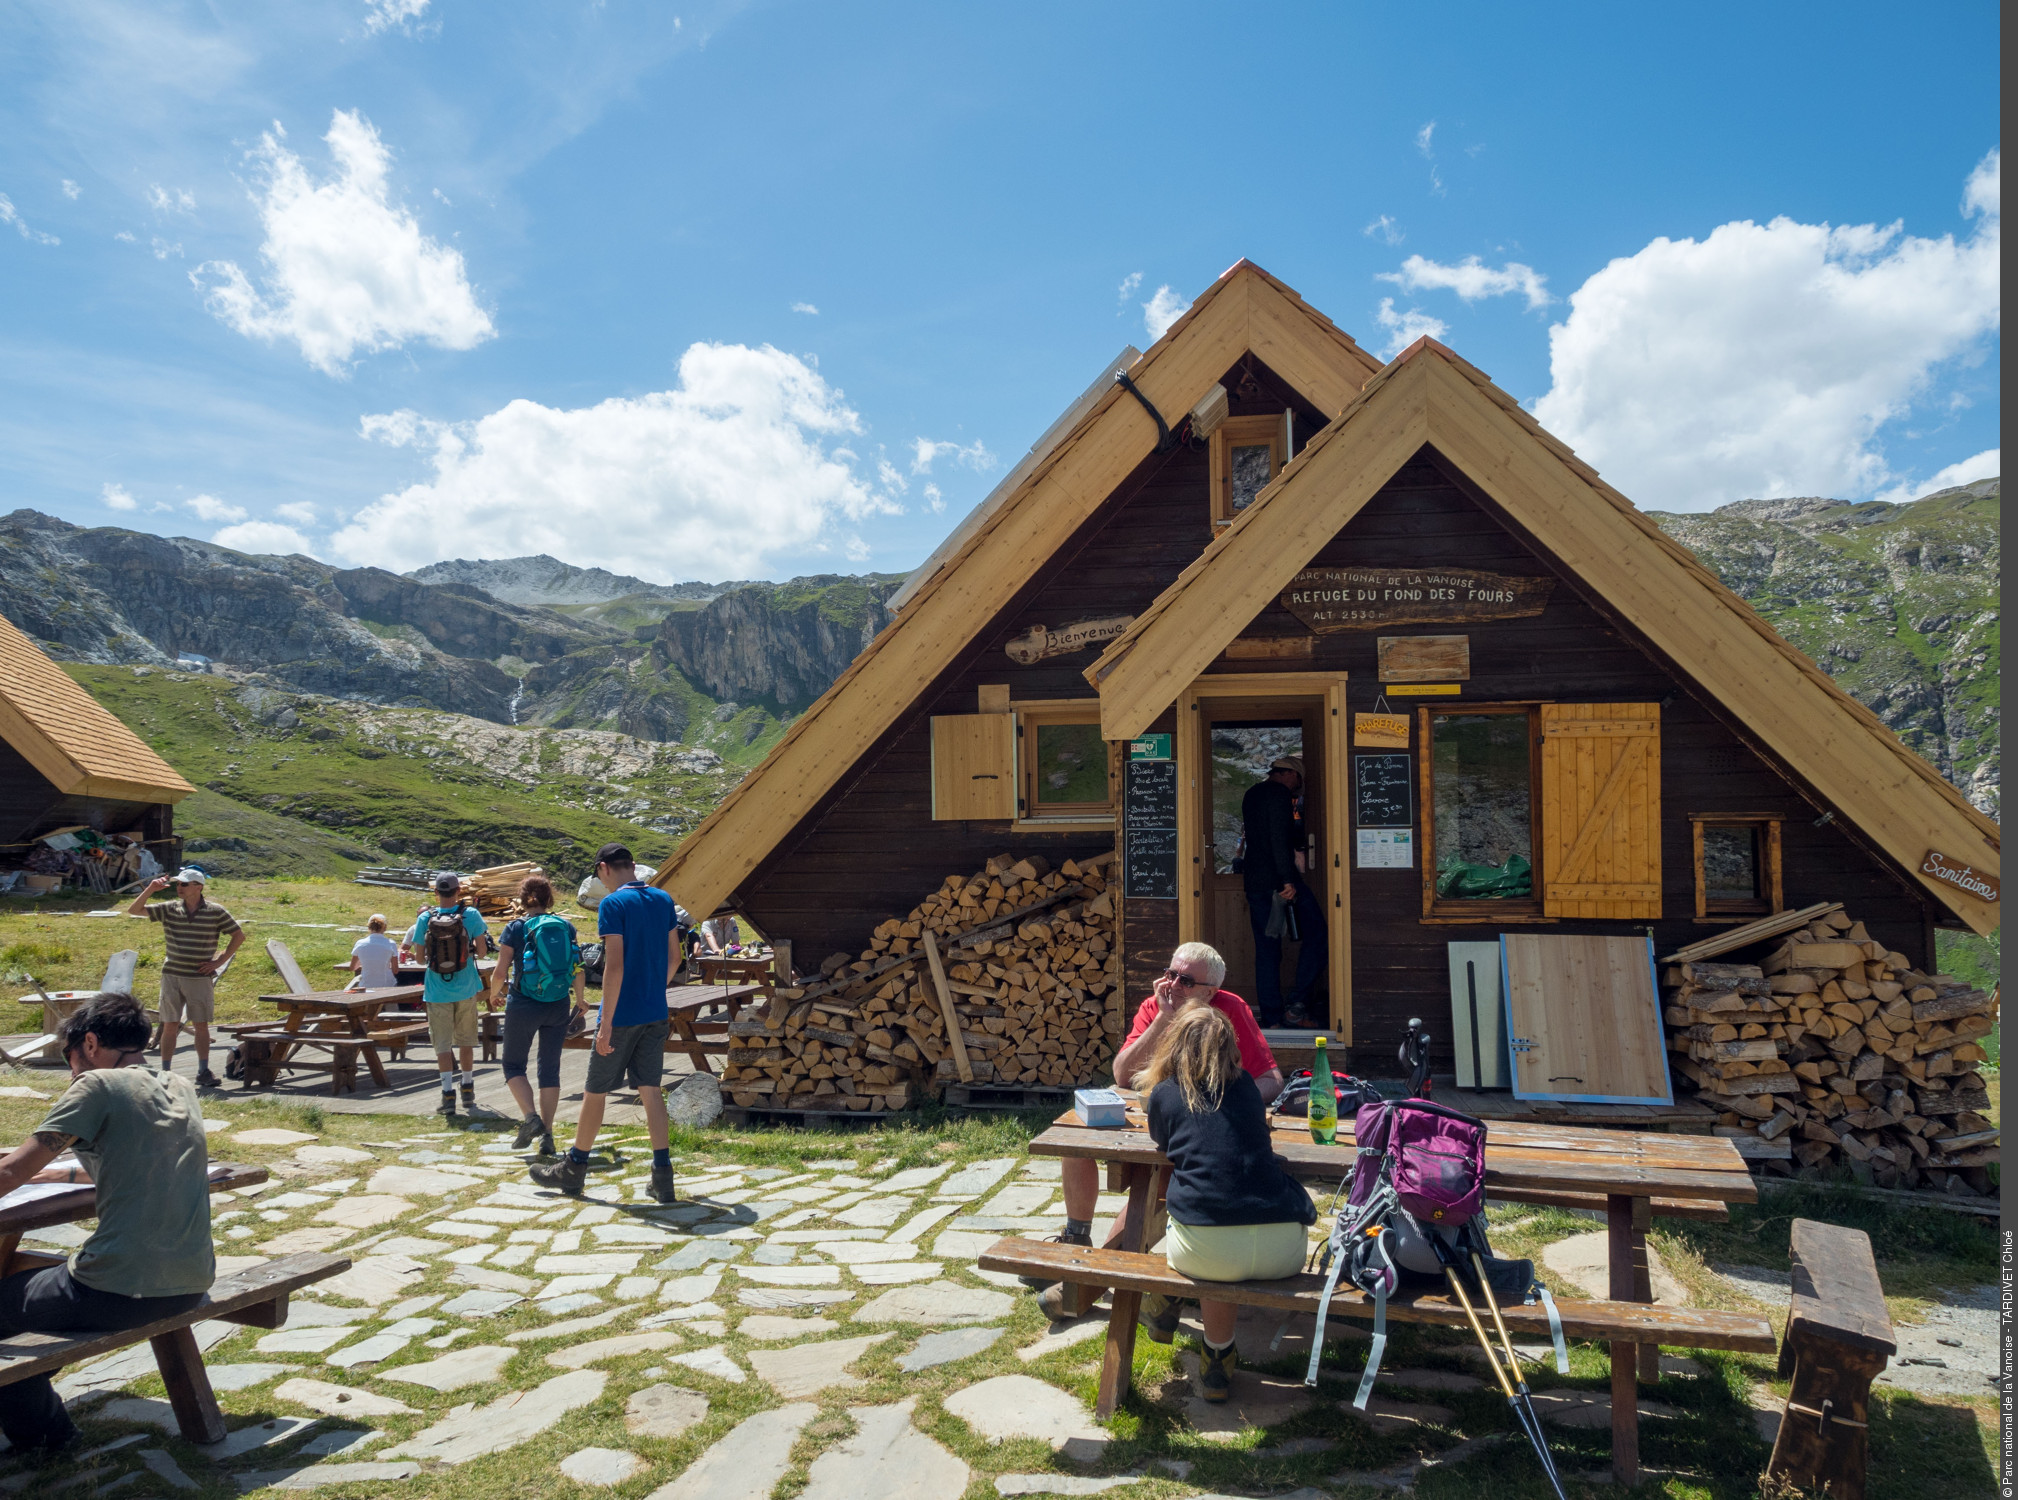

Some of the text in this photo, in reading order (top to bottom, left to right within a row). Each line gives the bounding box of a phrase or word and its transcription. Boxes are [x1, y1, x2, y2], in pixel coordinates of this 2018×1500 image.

[1294, 572, 1475, 589] PARC NATIONAL DE LA VANOISE
[1292, 588, 1514, 604] REFUGE DU FOND DES FOURS
[1313, 611, 1333, 620] ALT
[1342, 610, 1376, 620] 2530
[1045, 623, 1125, 648] Bienvenue
[1923, 852, 1997, 901] Sanitaires
